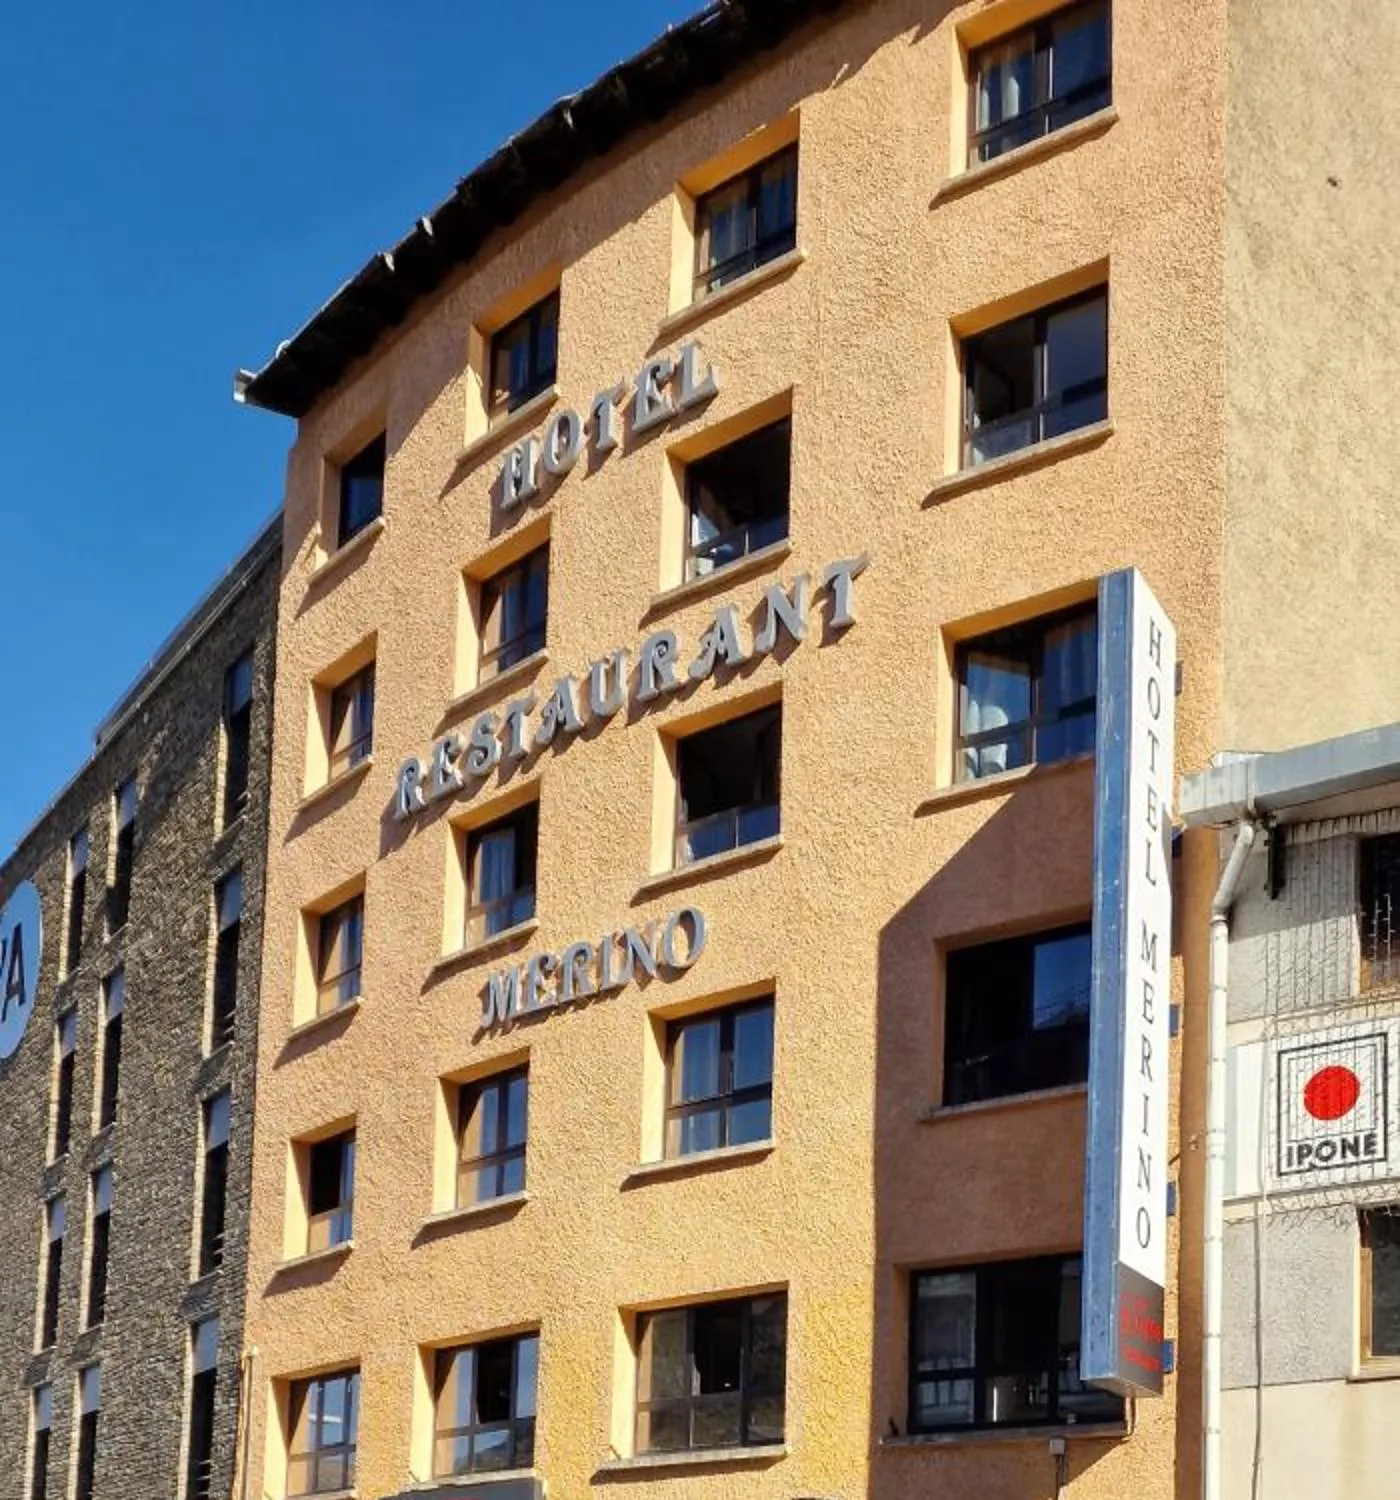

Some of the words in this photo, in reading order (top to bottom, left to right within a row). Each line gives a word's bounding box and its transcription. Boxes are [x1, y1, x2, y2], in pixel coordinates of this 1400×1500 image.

[502, 341, 719, 509] HOTEL
[394, 553, 867, 819] RESTAURANT
[1145, 616, 1163, 887] HOTEL
[480, 907, 707, 1028] MERINO
[1136, 920, 1158, 1248] MERINO
[1285, 1133, 1378, 1167] IPONE
